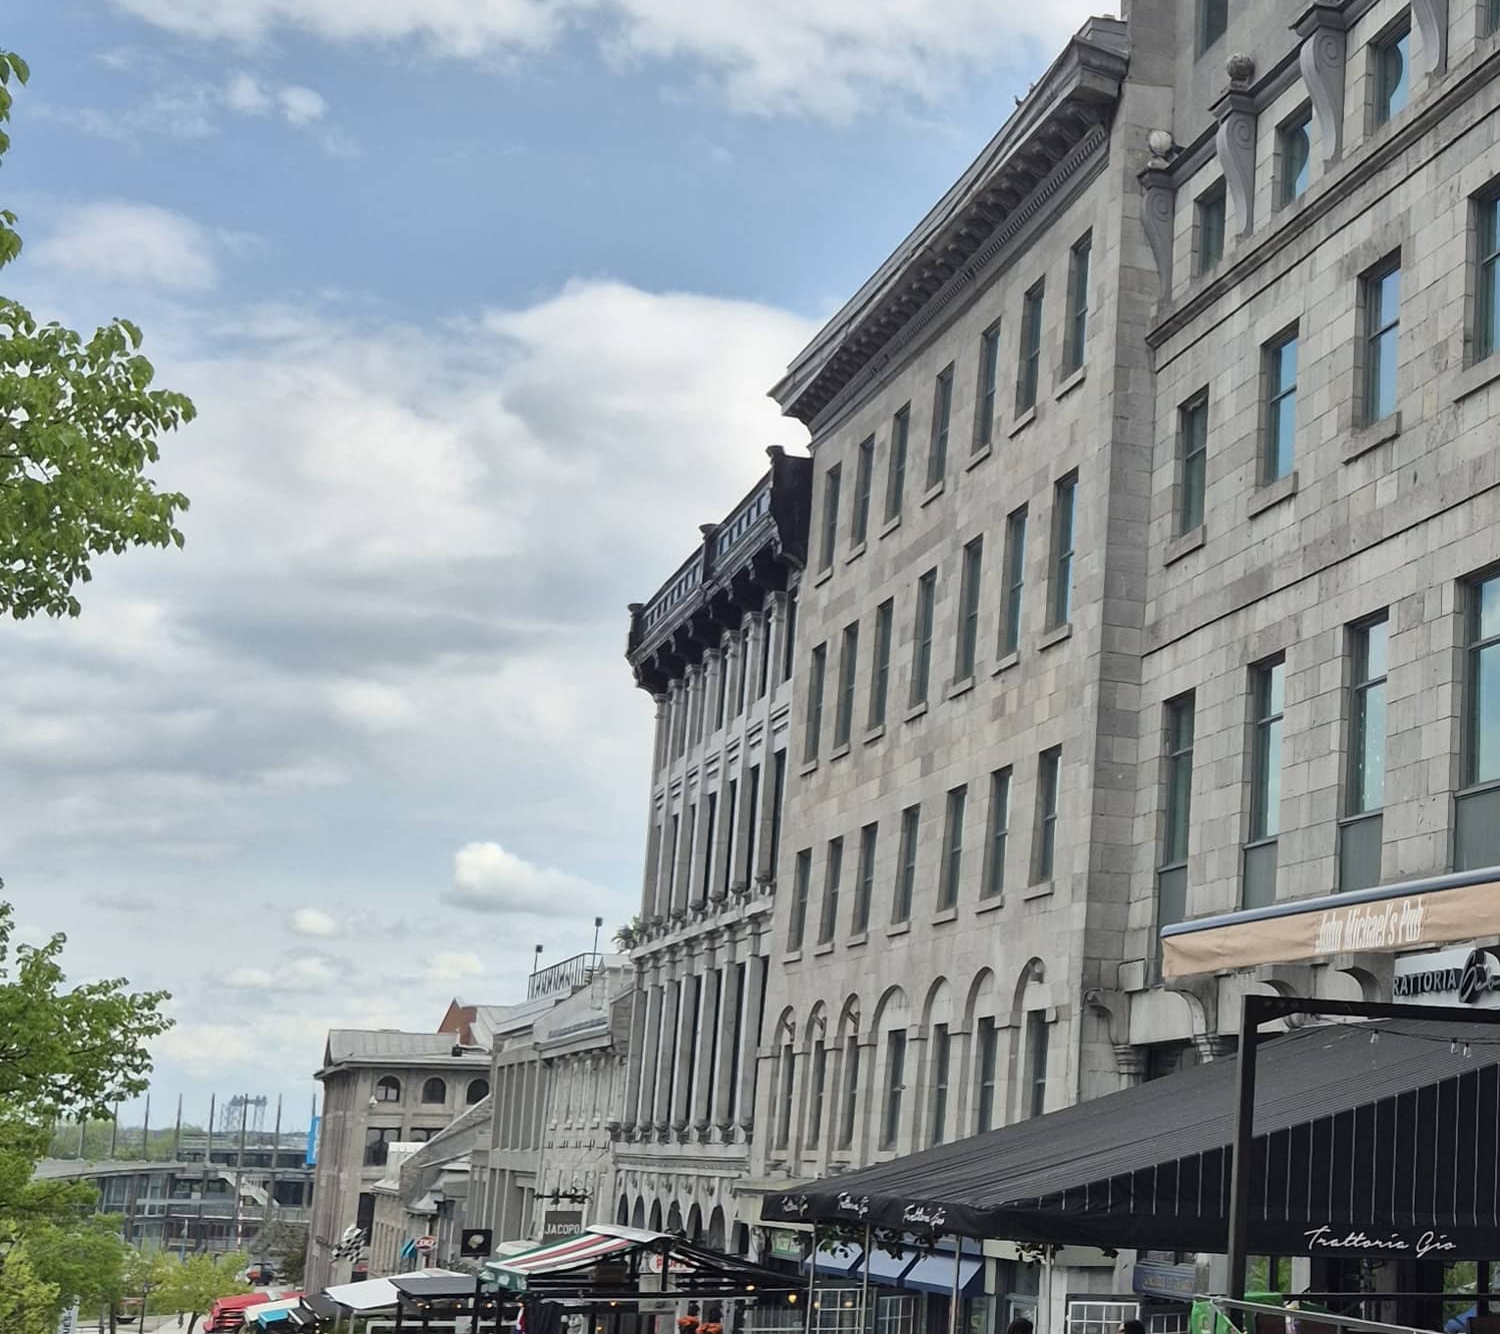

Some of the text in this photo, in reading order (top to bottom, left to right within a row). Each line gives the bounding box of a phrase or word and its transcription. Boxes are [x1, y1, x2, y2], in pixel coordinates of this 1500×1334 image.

[1315, 897, 1425, 954] John Michael's Pub
[1392, 968, 1459, 997] RATTORIA
[1303, 1225, 1457, 1259] Trattoria Gio
